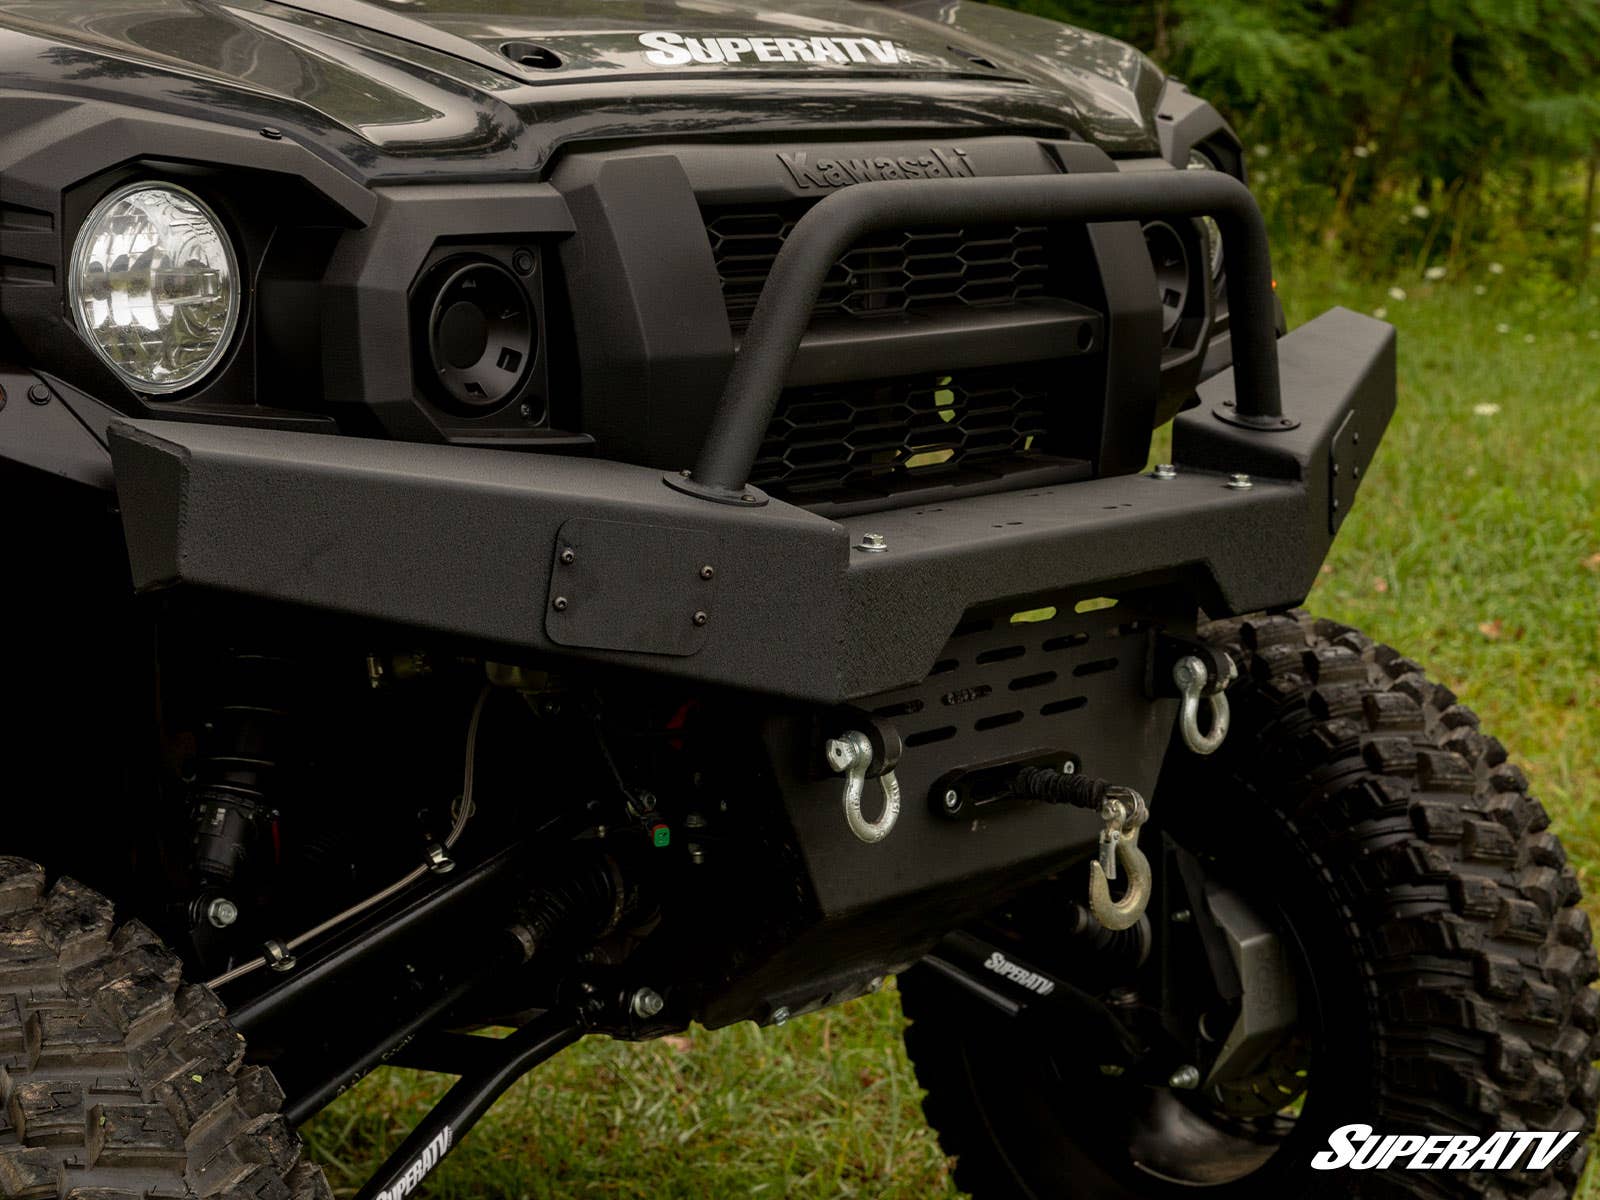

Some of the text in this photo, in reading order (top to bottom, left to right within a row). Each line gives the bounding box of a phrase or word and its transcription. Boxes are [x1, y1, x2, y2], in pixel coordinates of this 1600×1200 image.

[638, 32, 901, 66] SUPERATV
[777, 147, 976, 190] Kawasaki
[984, 951, 1054, 994] SUPERATV
